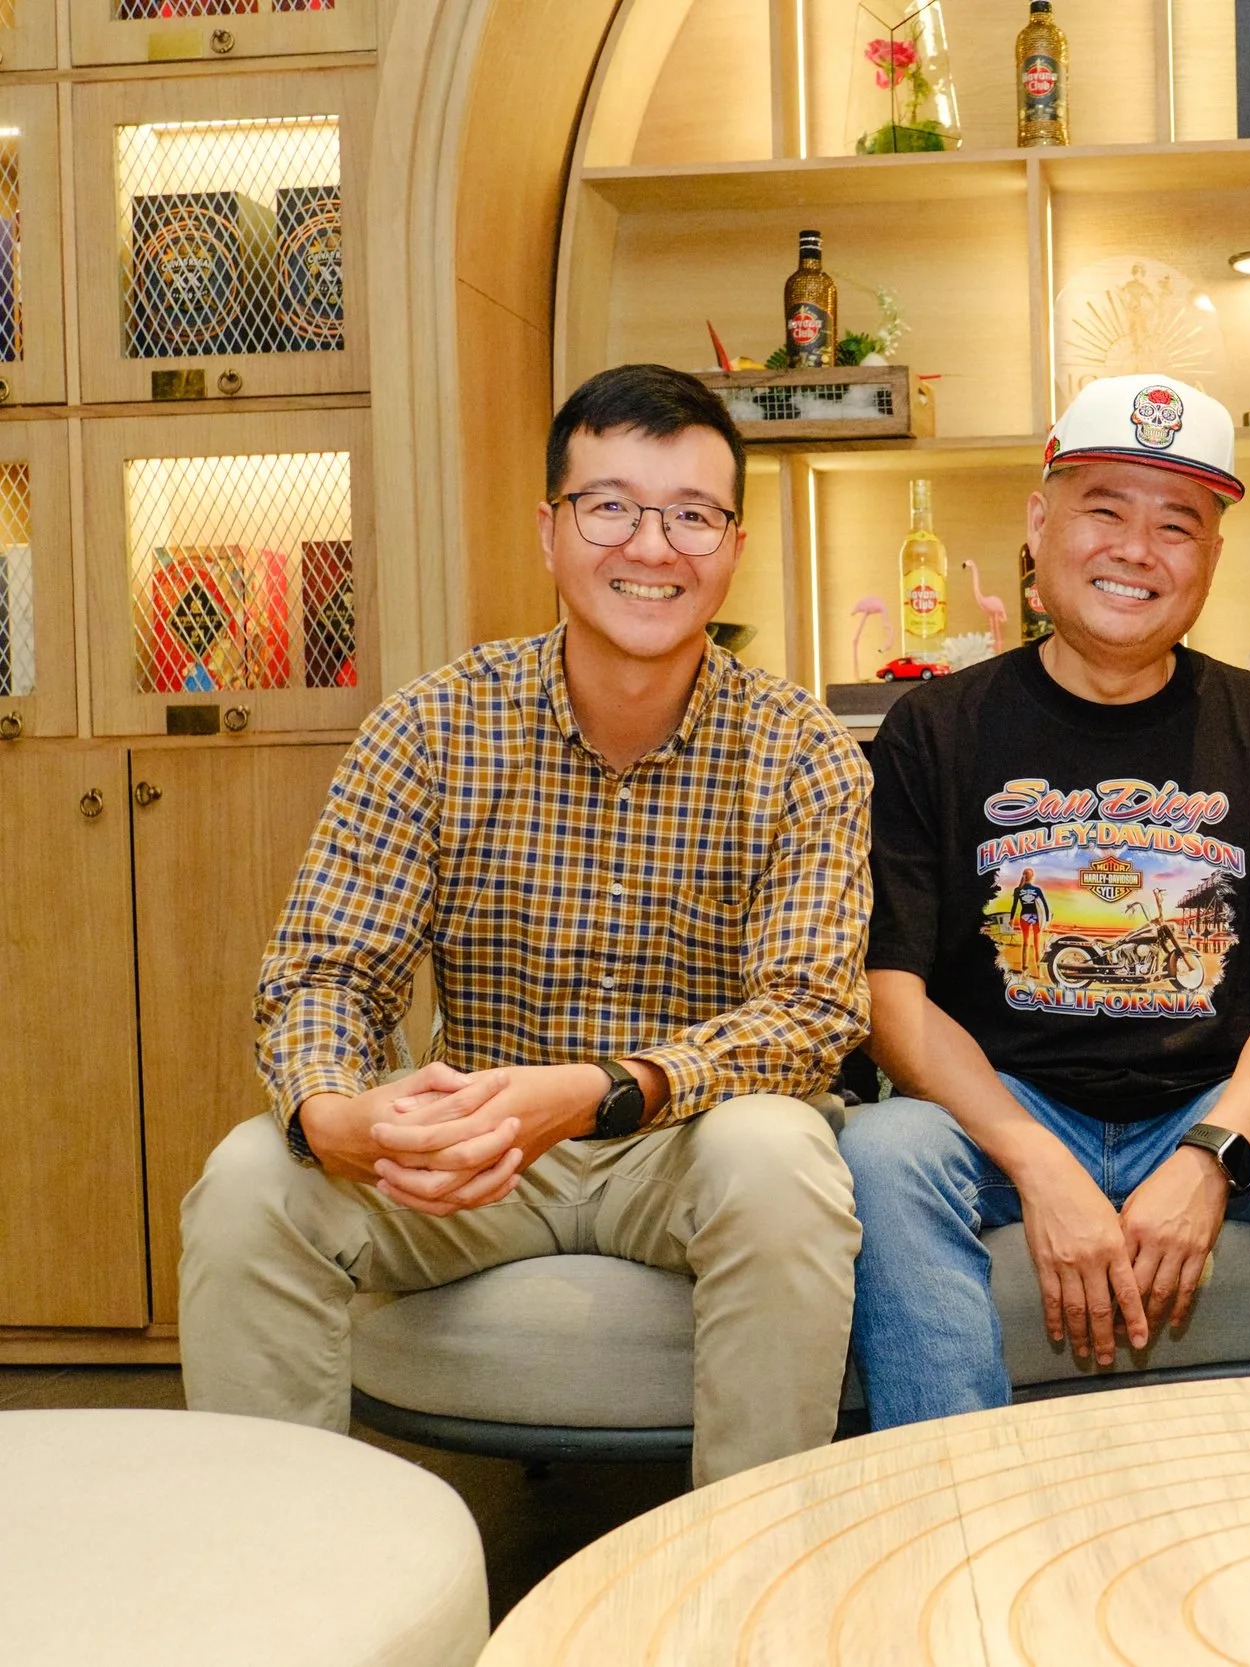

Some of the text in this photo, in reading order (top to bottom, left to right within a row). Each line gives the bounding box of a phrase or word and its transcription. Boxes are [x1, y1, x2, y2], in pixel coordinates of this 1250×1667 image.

[984, 778, 1229, 832] San Diego
[977, 820, 1247, 878] HARLEY-DAVIDSON
[1096, 860, 1126, 872] MOTOR
[1083, 873, 1139, 885] HARLEY-DAVIDSON
[1096, 886, 1127, 900] CYCLES
[1005, 983, 1216, 1018] CALIFORNIA
